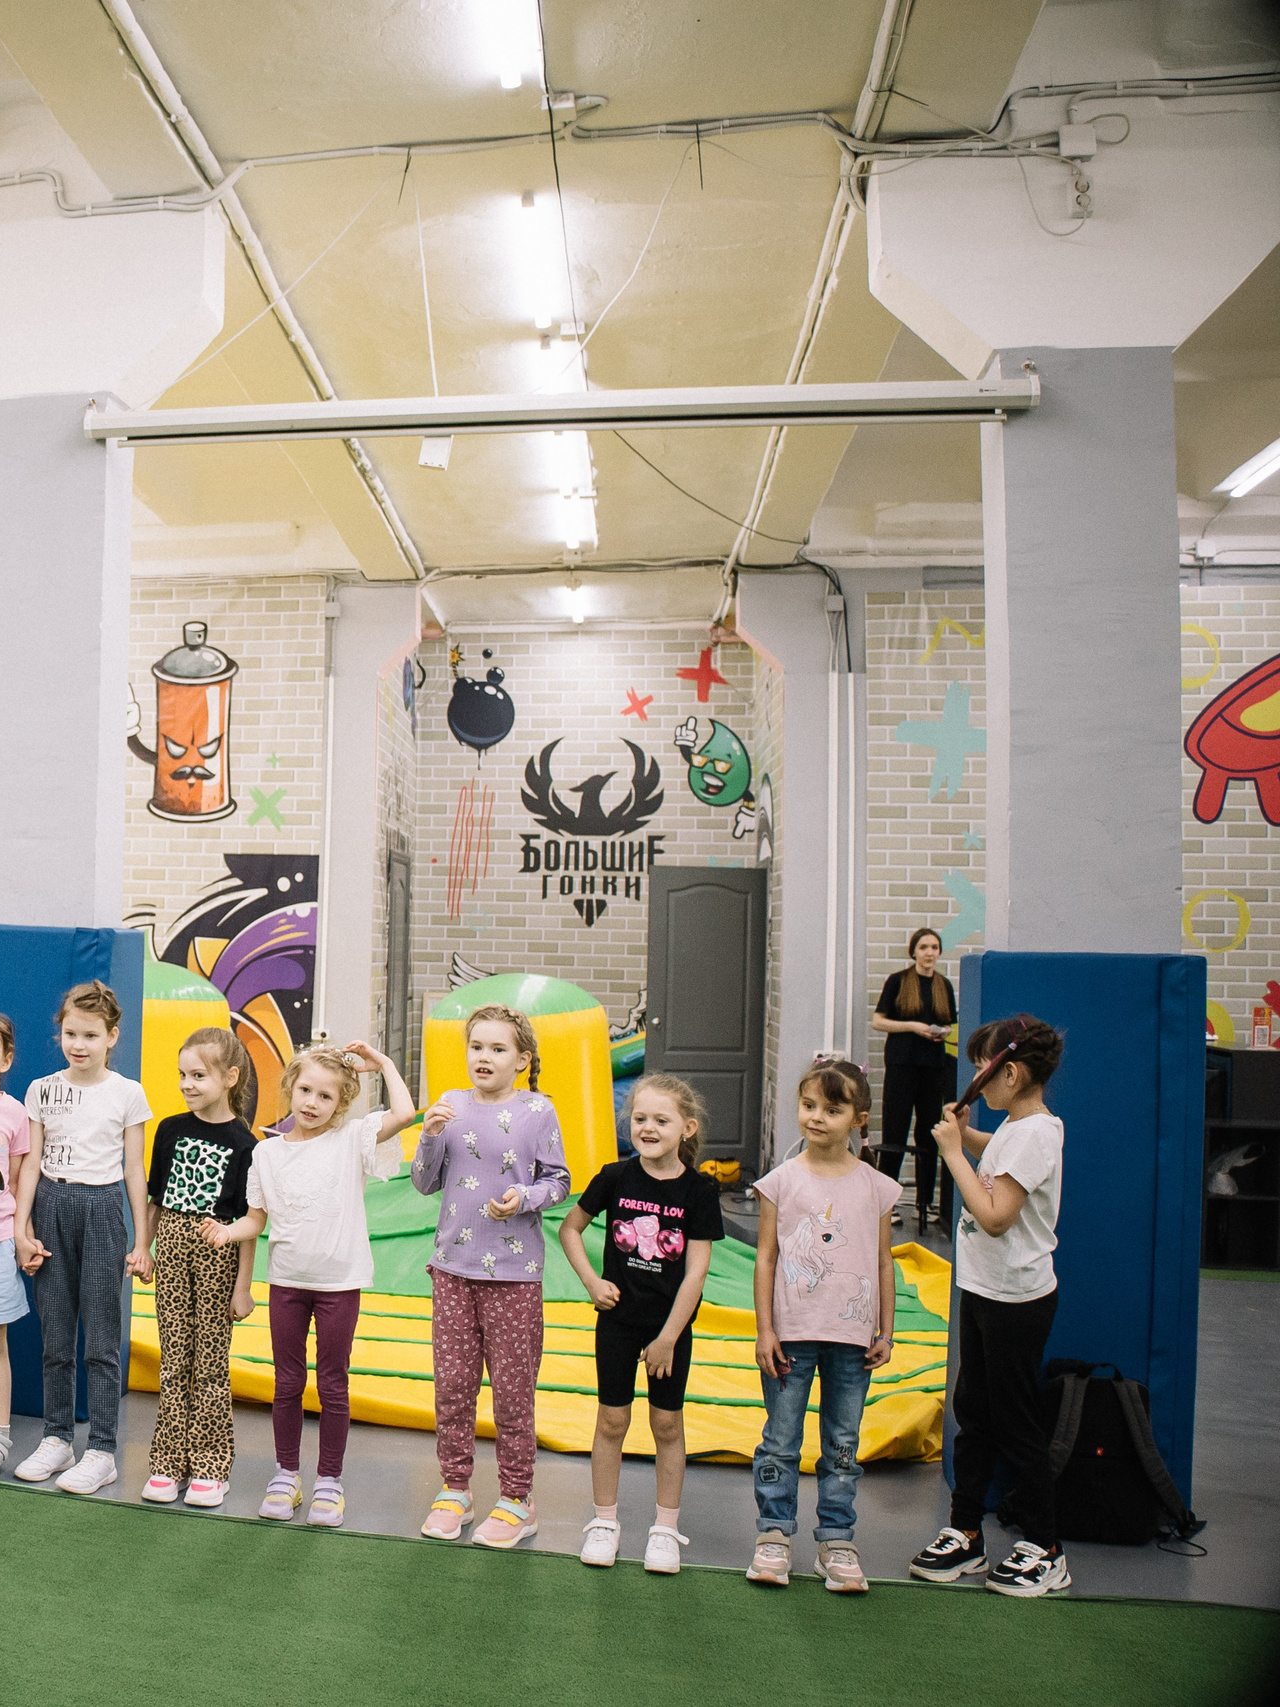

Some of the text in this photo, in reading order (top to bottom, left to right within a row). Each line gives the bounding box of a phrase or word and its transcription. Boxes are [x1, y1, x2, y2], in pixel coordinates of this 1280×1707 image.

[518, 834, 666, 874] БОЛЬШИЕ
[542, 874, 641, 901] ГОНКИ
[619, 1198, 685, 1219] FOREVER LOV
